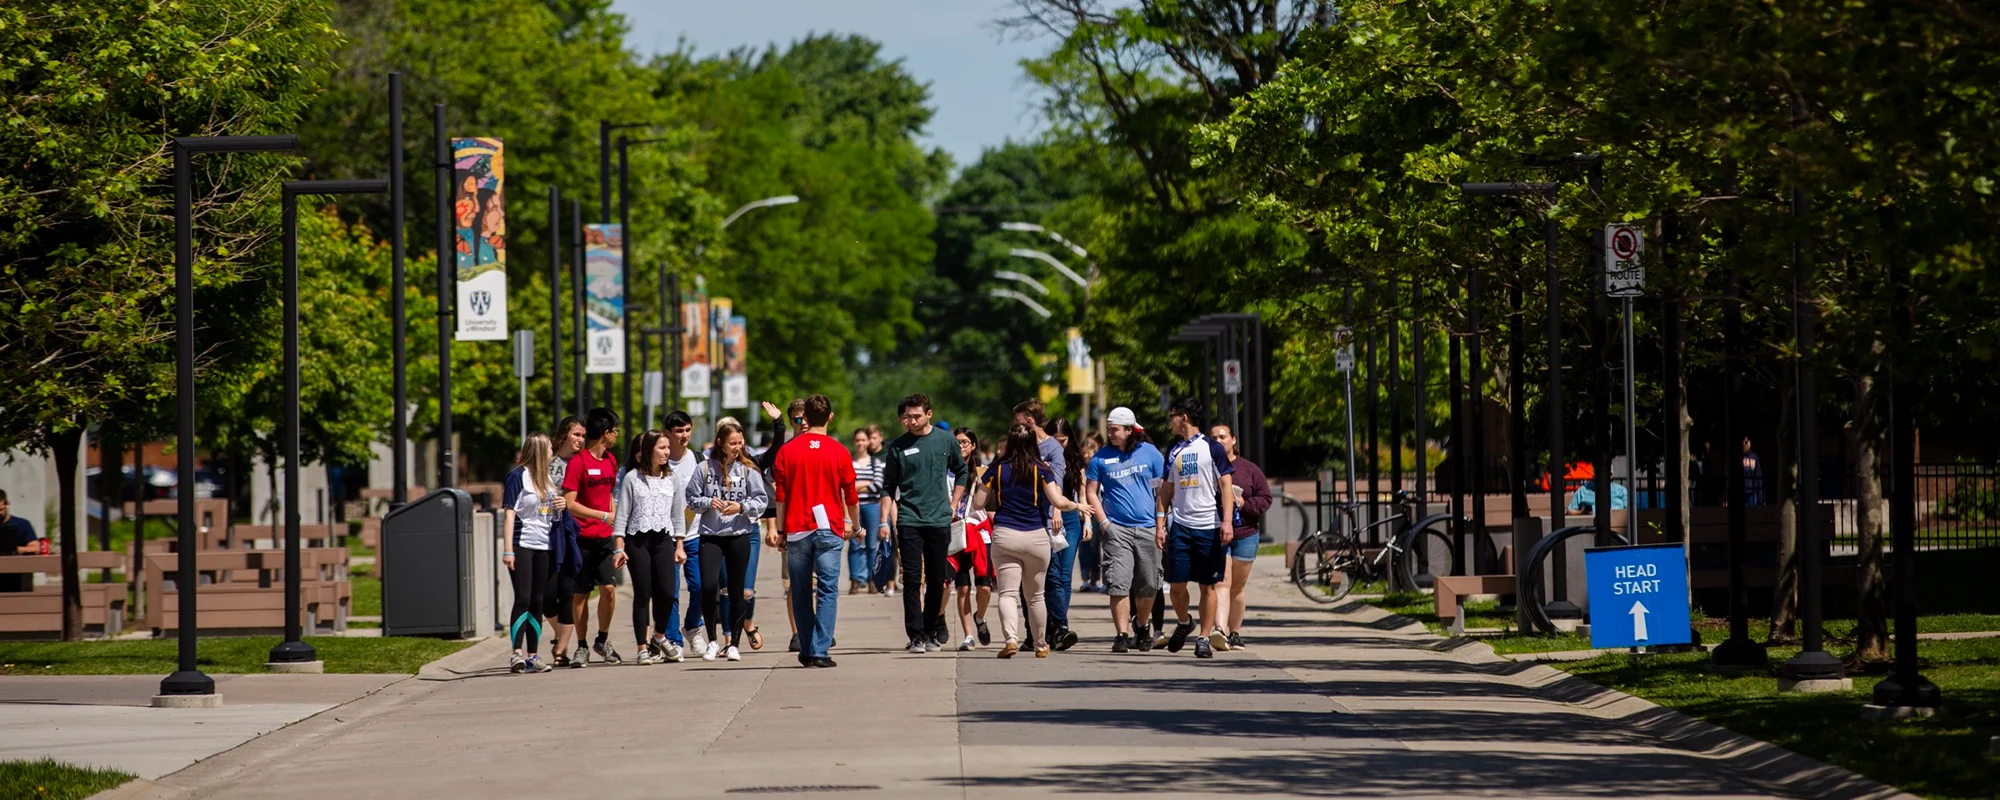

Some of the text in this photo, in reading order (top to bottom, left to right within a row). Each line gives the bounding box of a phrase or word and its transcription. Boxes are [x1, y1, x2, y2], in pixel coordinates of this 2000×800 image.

[1610, 270, 1641, 280] ROUTE
[809, 440, 820, 449] 36
[706, 474, 745, 488] GREAT
[1615, 564, 1657, 578] HEAD
[1613, 580, 1661, 595] START
